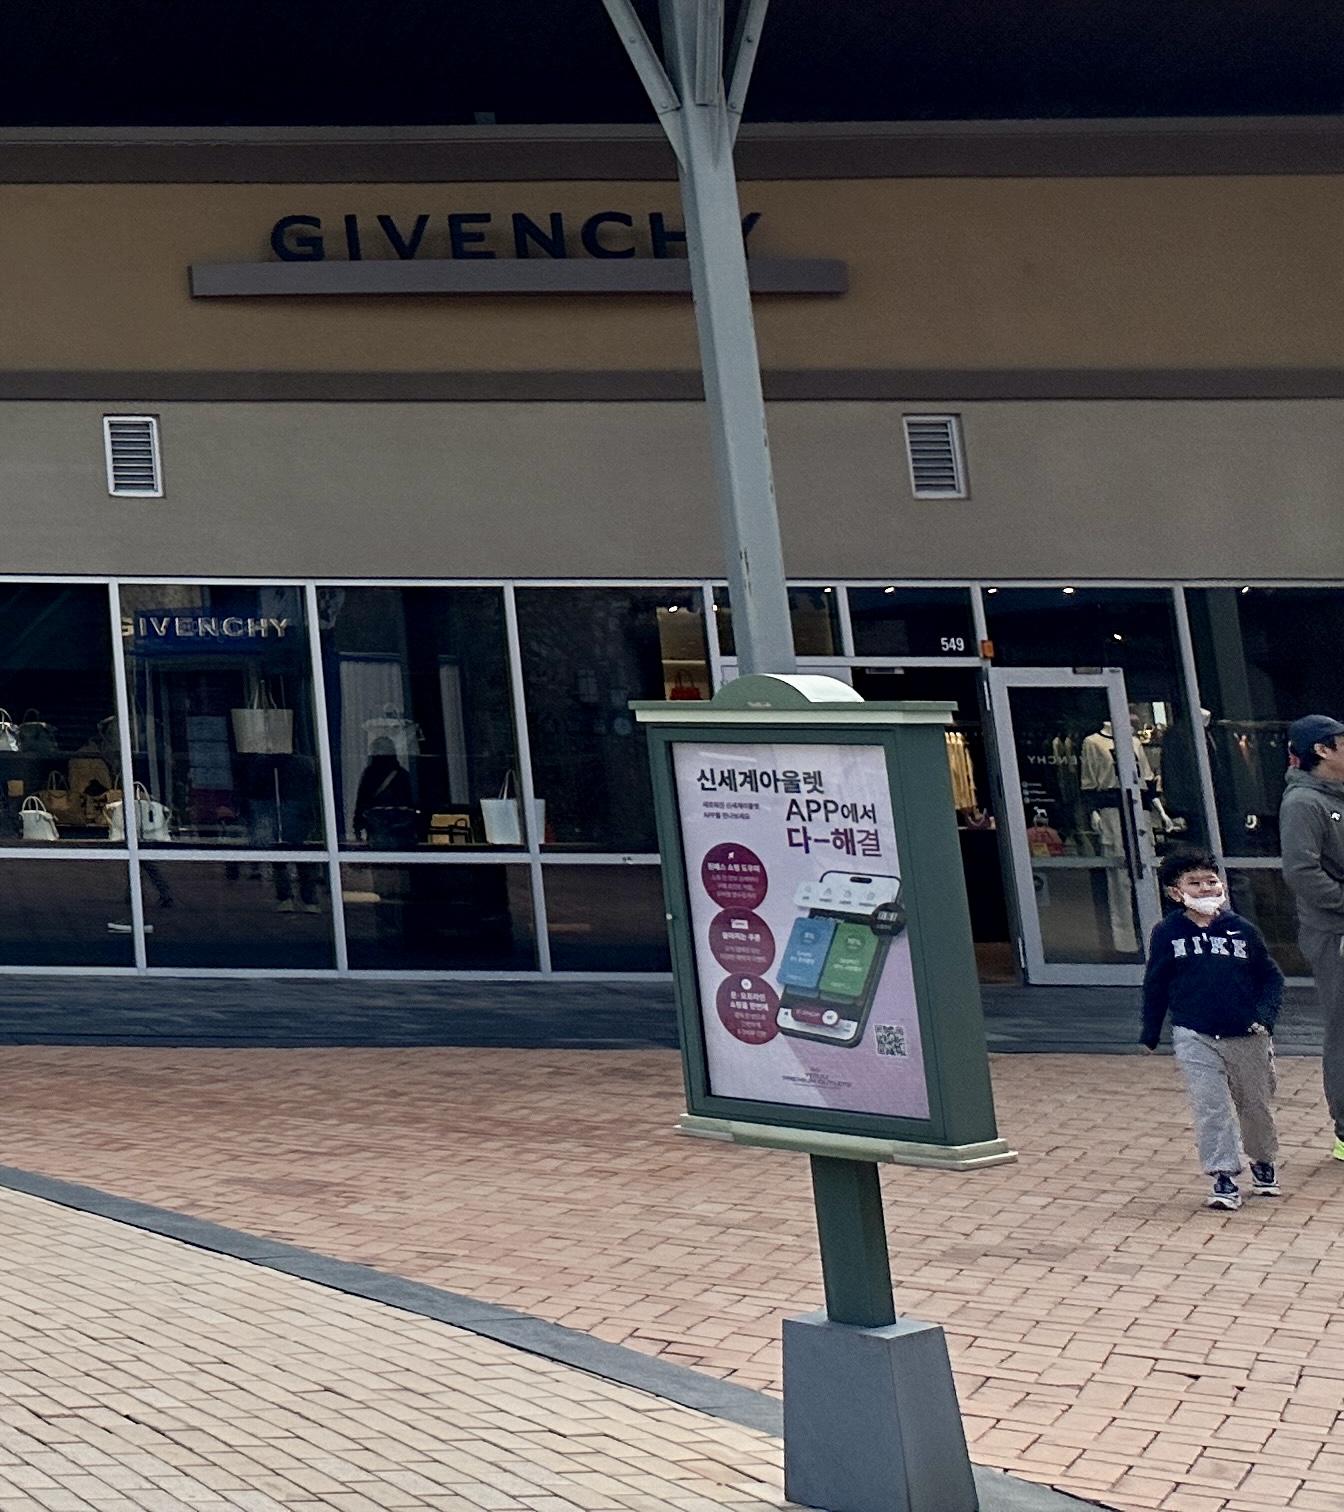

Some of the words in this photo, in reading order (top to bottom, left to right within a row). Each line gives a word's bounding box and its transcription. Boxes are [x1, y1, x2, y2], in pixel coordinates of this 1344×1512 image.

[940, 637, 965, 652] 549
[696, 768, 824, 794] 신세계아울렛
[786, 799, 877, 825] APP에서
[1171, 935, 1248, 958] NIKE
